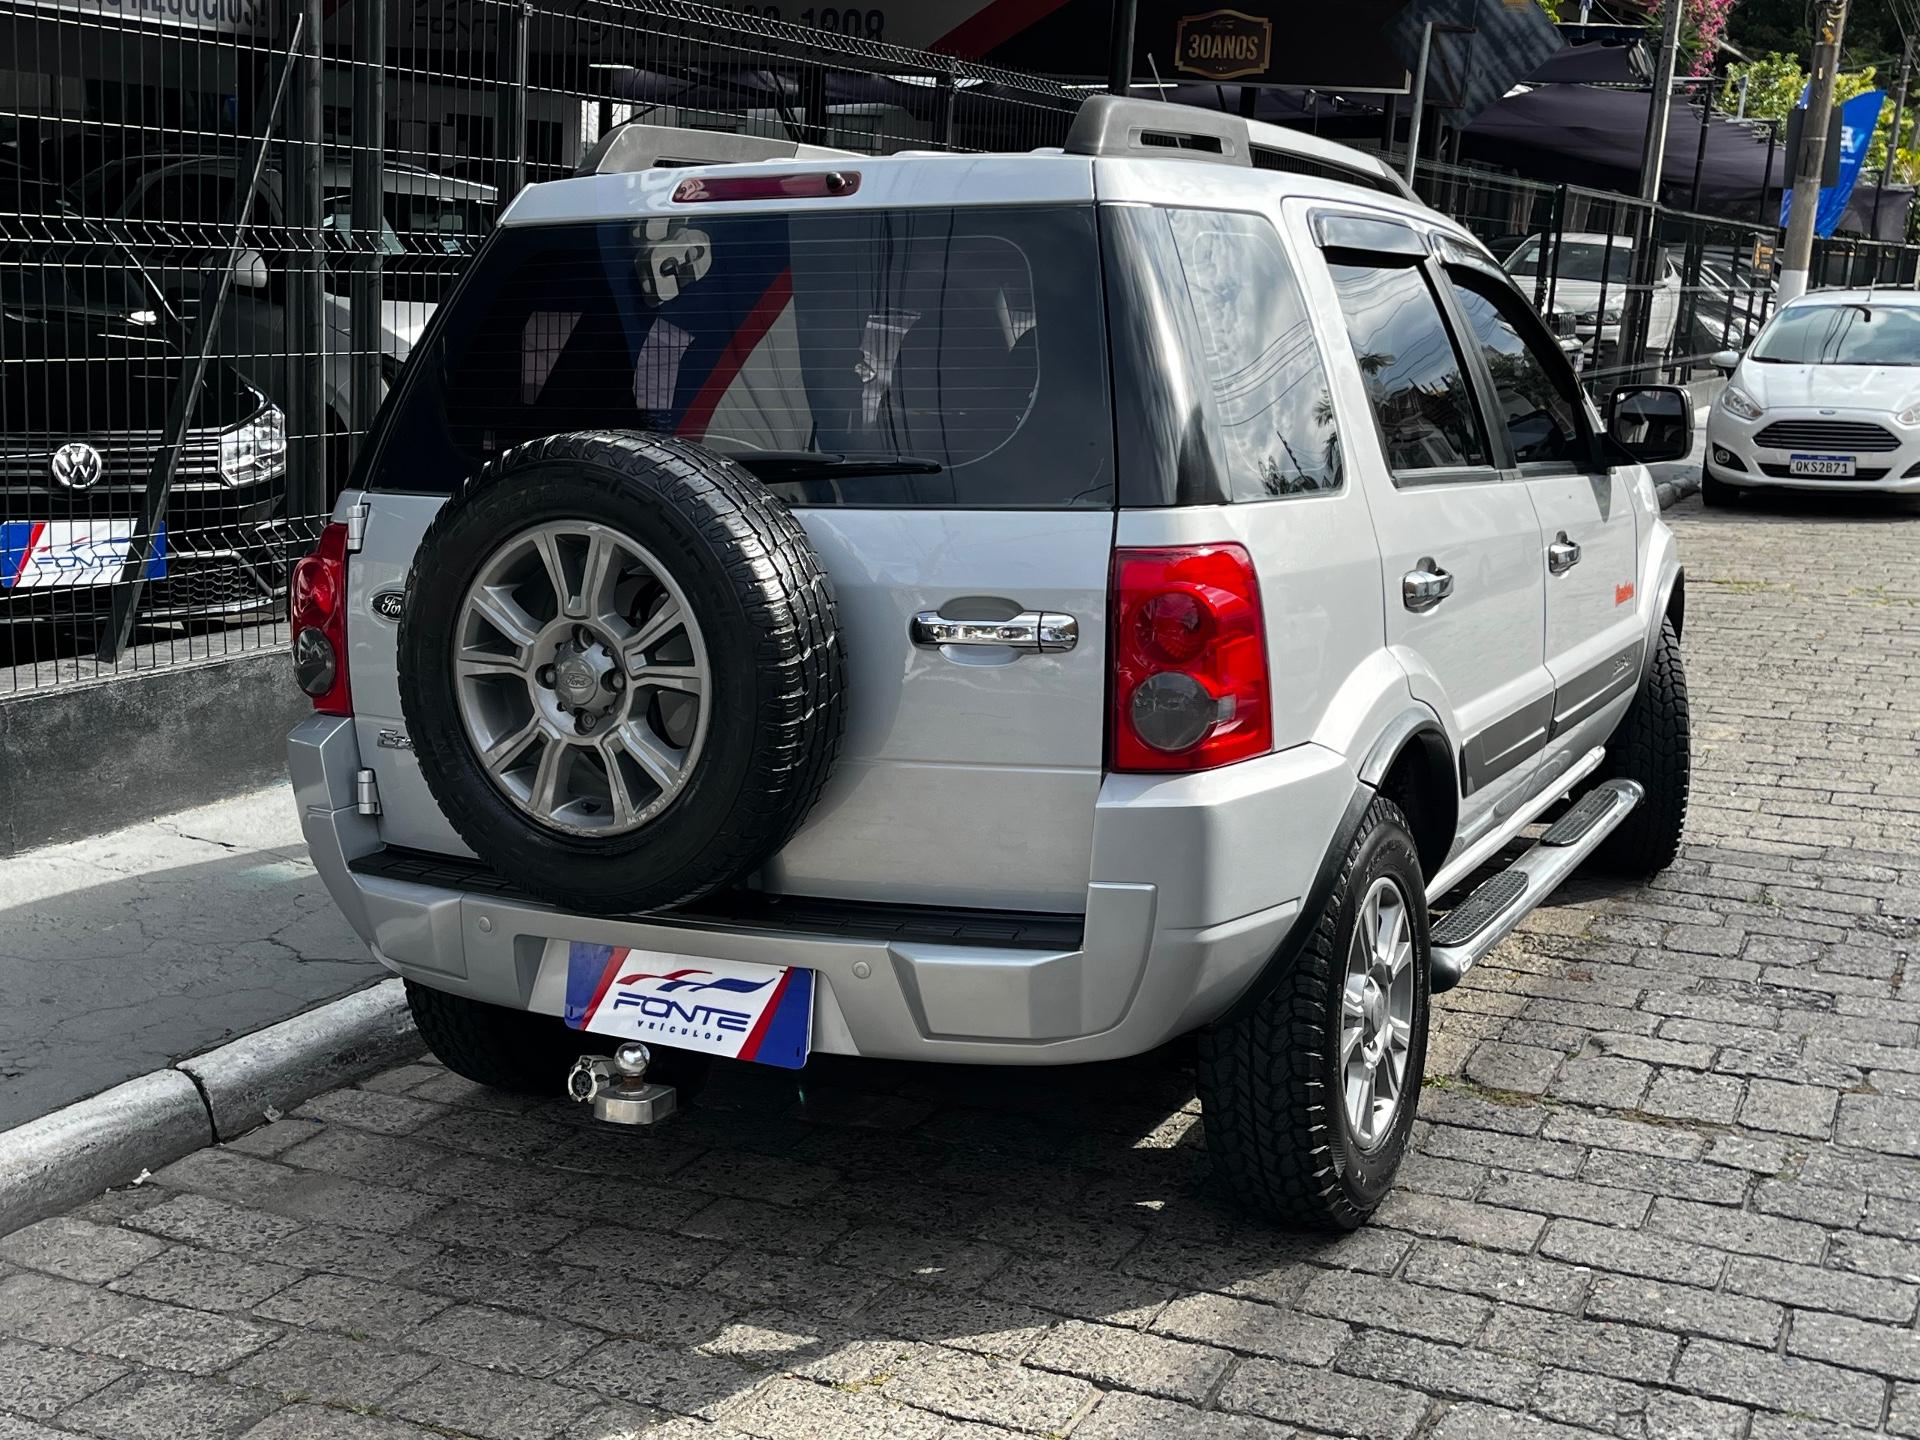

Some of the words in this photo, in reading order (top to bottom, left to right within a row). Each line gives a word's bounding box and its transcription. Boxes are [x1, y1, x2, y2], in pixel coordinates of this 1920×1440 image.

[381, 594, 402, 614] For
[613, 991, 751, 1033] FONTE
[637, 1020, 723, 1042] VEÍCULOS
